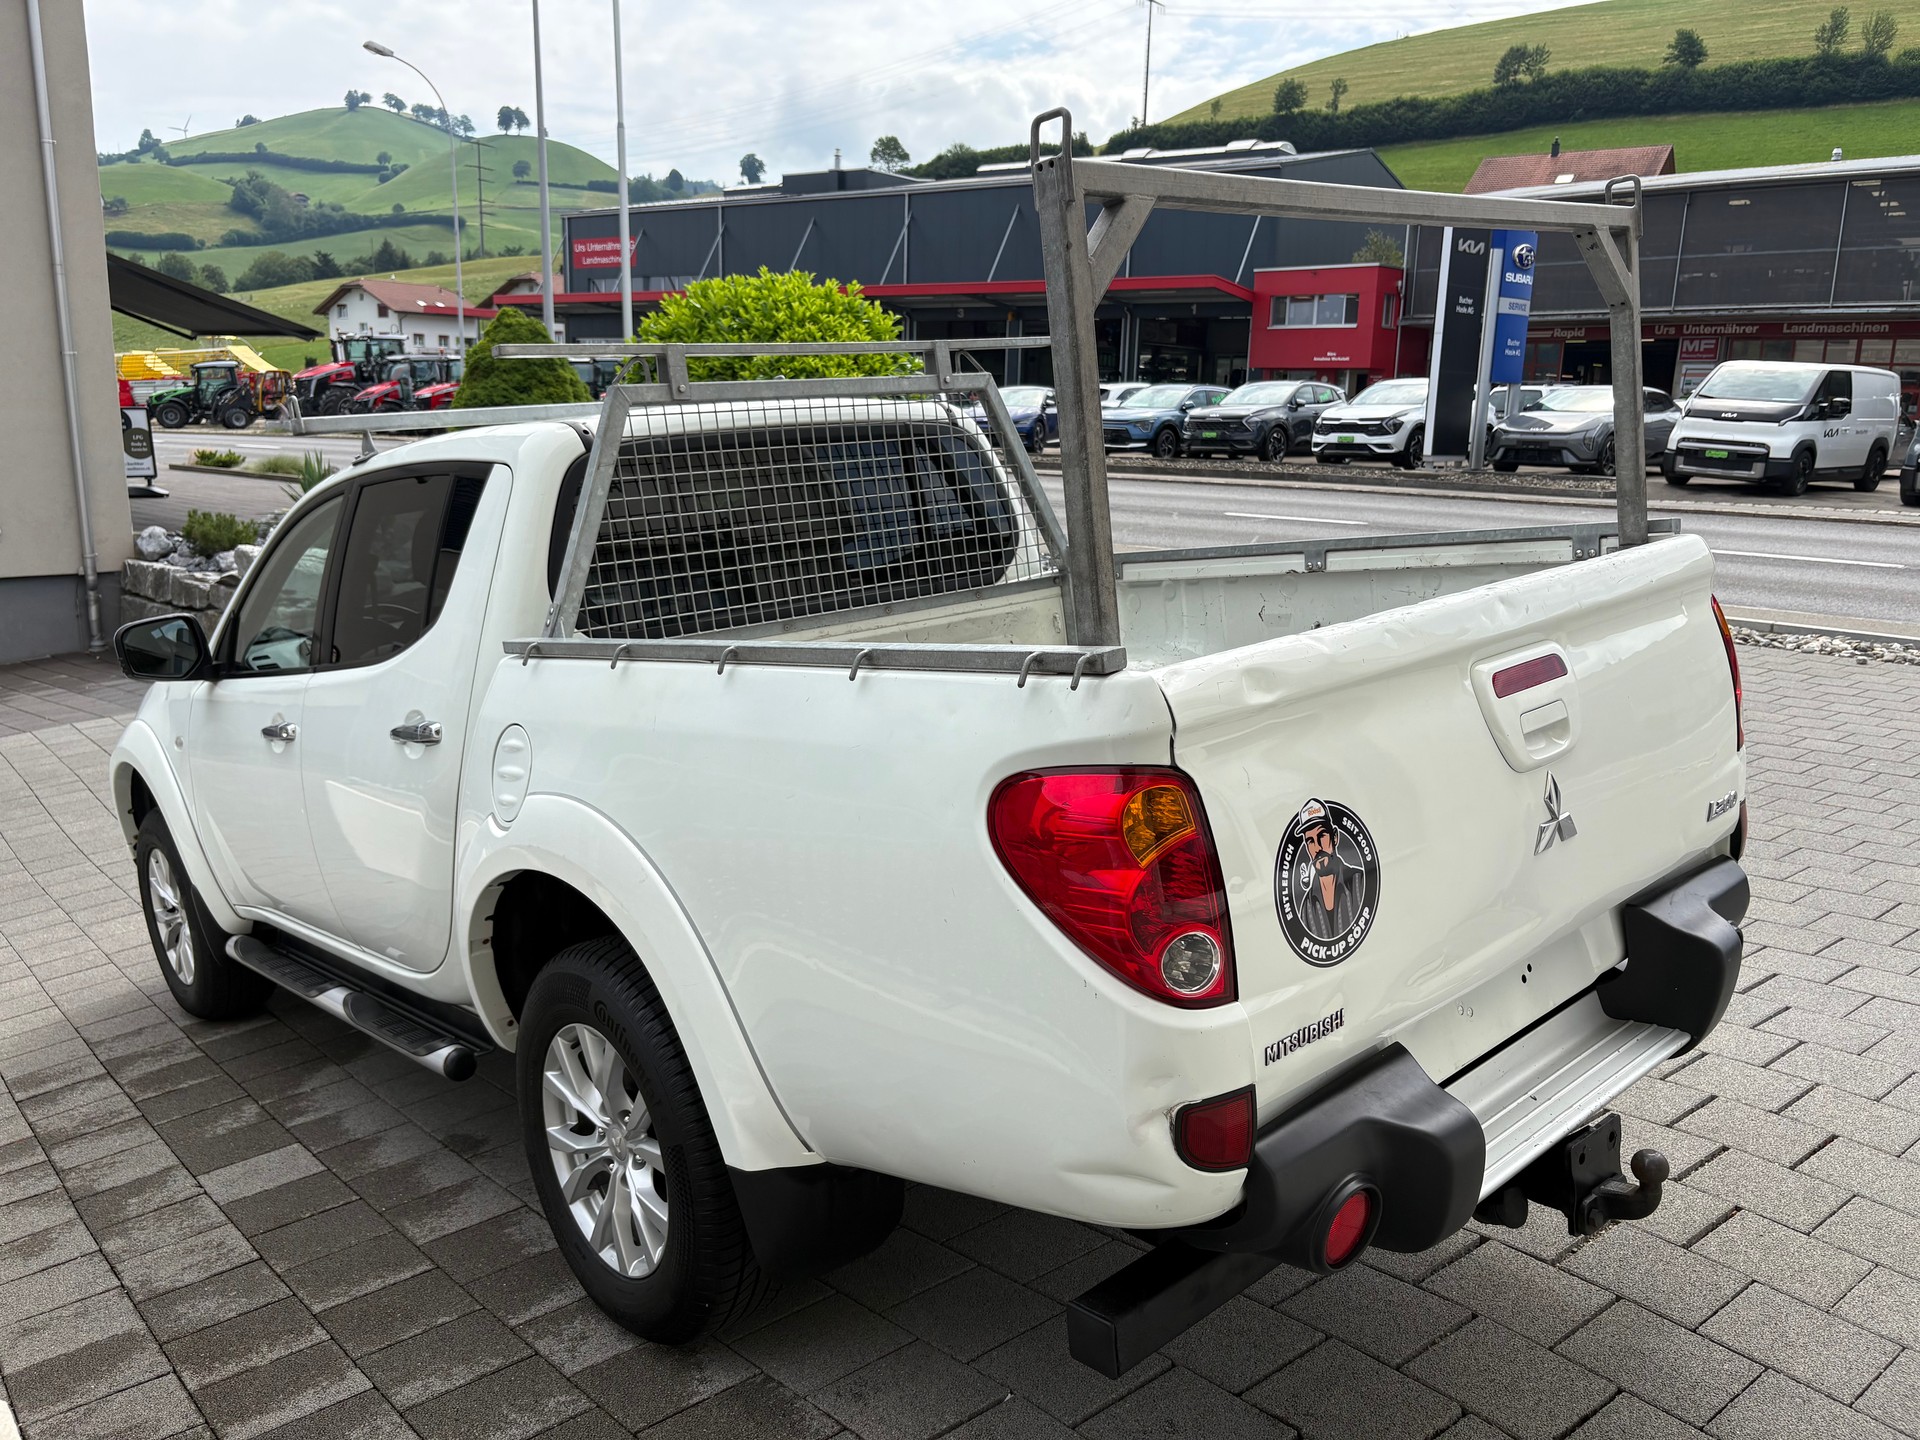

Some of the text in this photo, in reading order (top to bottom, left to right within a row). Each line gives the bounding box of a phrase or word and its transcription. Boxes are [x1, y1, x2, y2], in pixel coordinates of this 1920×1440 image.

[587, 242, 622, 251] Unternähre
[1457, 238, 1486, 256] KIA
[1505, 272, 1534, 286] SUBARU
[957, 308, 965, 319] 3
[1508, 302, 1528, 312] SERVICE
[1553, 327, 1586, 339] Rapid
[1654, 322, 1890, 335] Urs Unternährer Landmaschinen
[1681, 339, 1717, 353] MF
[1823, 428, 1840, 439] KIA
[1341, 816, 1372, 862] SEIT 2009
[1281, 843, 1295, 921] ENTLEBUCH
[1300, 906, 1371, 960] PICK-UP SÖPP
[1264, 1007, 1345, 1067] MITSUBISHI
